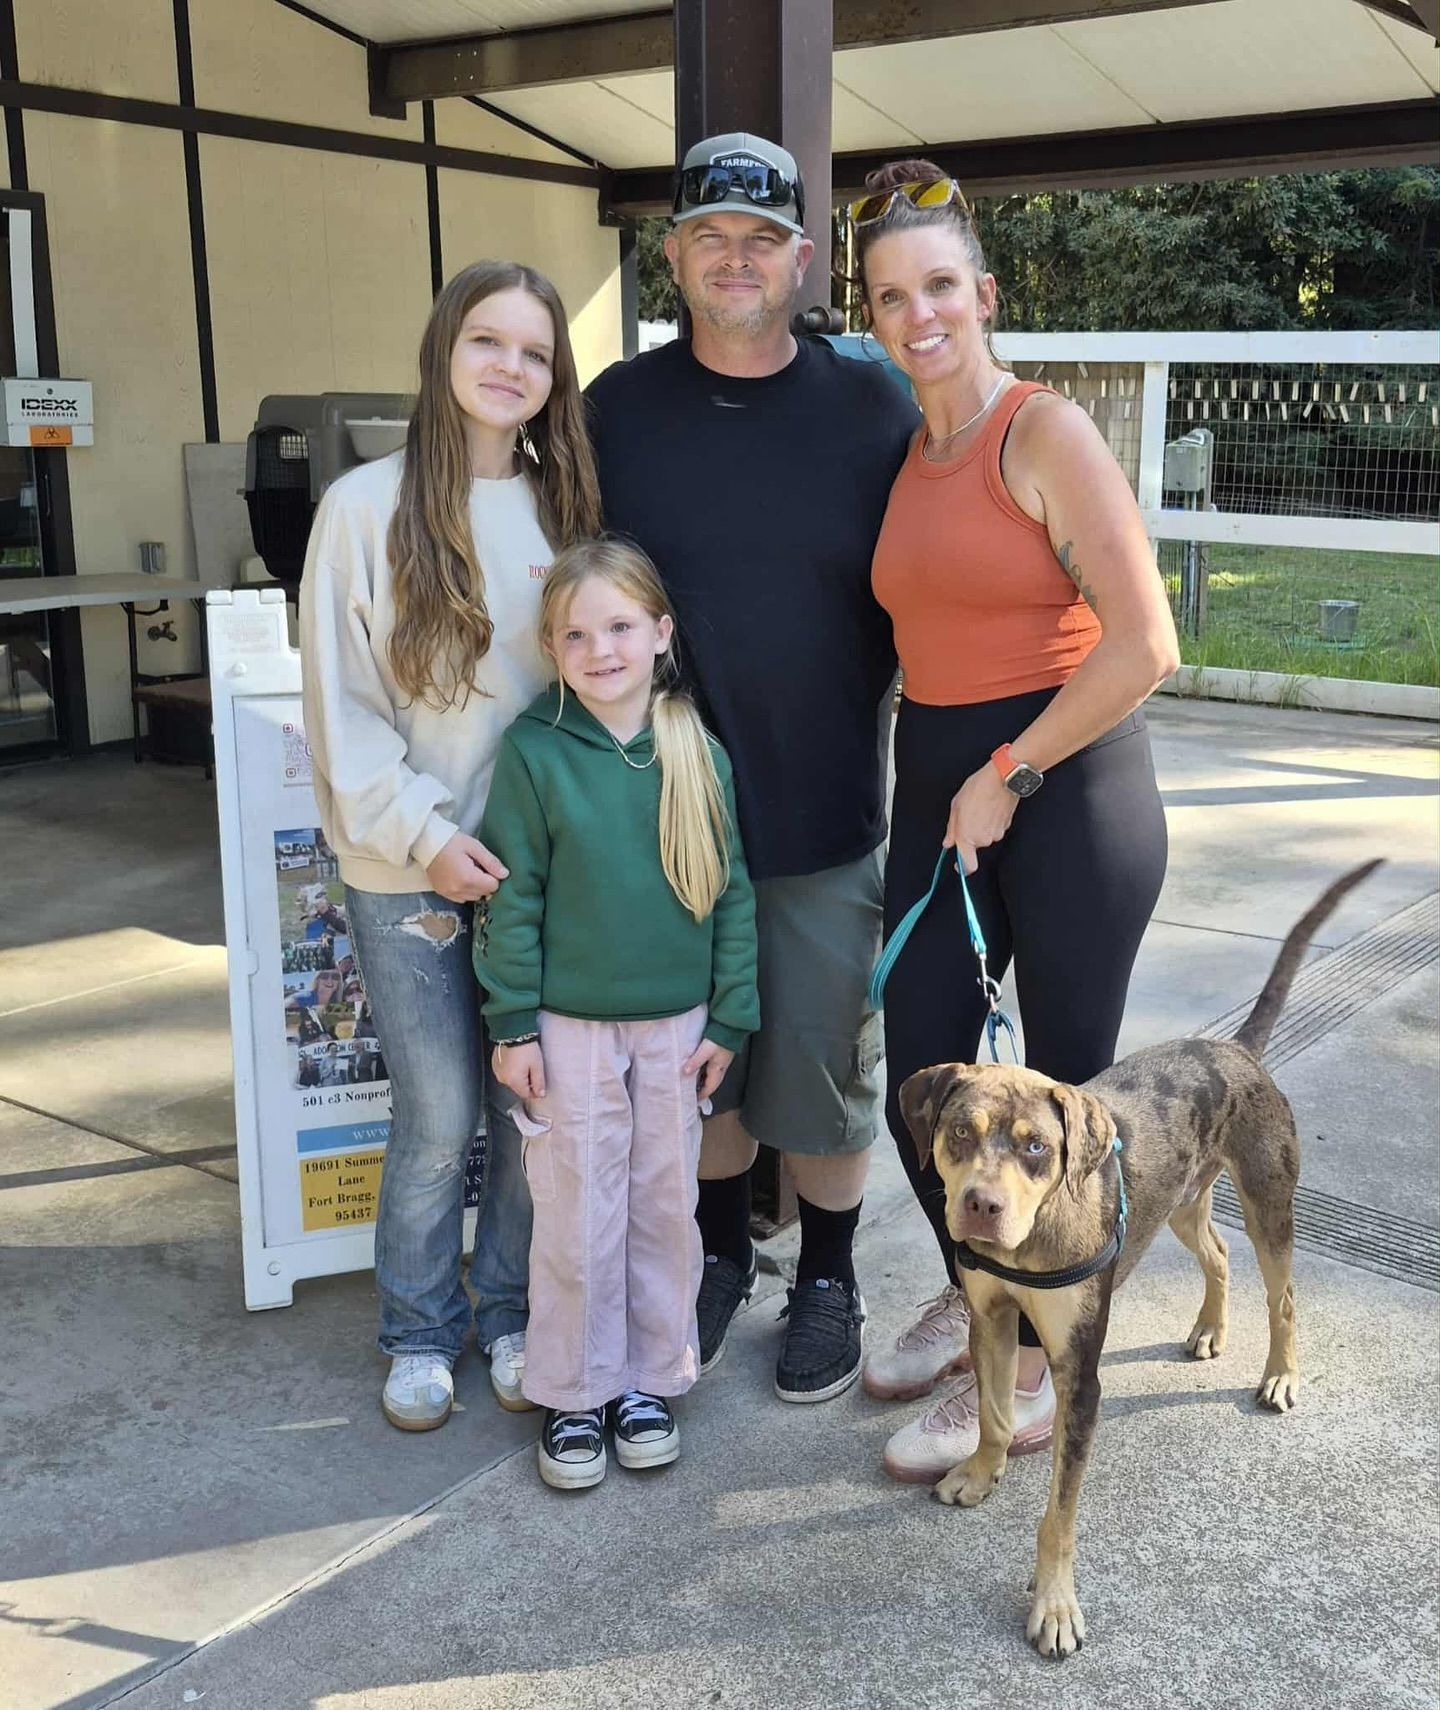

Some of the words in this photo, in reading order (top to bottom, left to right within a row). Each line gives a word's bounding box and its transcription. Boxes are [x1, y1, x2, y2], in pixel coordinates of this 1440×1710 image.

[21, 398, 78, 411] IDEXX
[302, 1095, 323, 1108] 501
[305, 1159, 340, 1174] 19691
[337, 1175, 366, 1187] Lane
[308, 1196, 333, 1209] Fort
[335, 1206, 372, 1222] 95437
